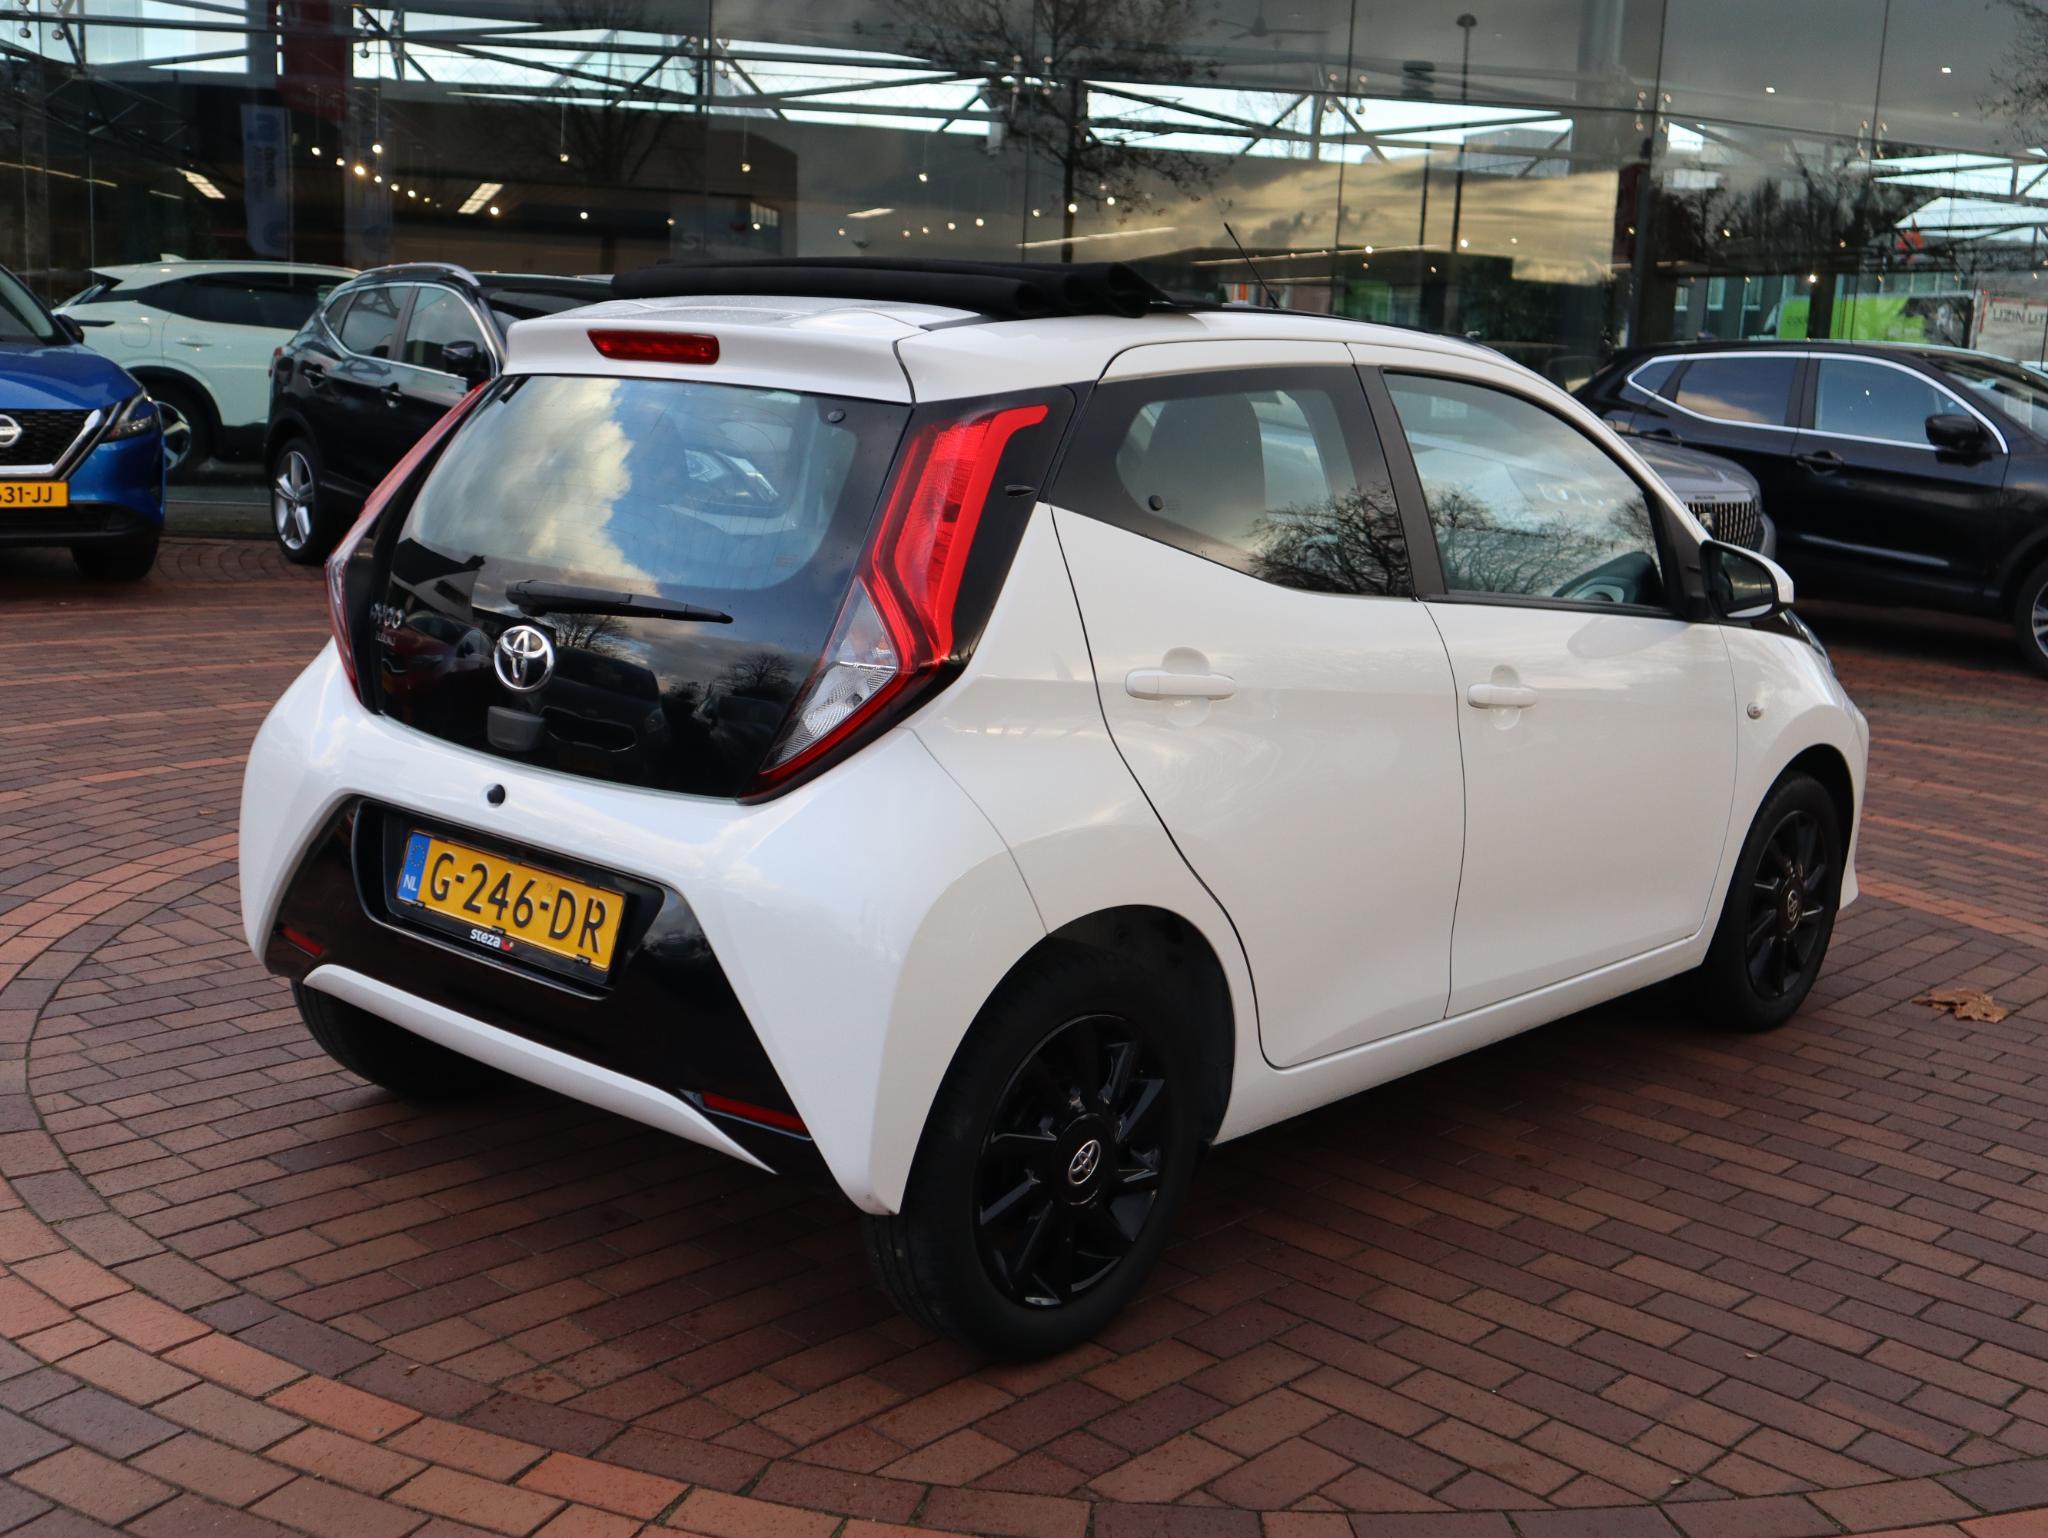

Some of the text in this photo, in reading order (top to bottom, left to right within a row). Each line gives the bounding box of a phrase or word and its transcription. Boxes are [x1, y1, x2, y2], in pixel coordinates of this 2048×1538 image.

[0, 486, 52, 503] 31-JJ
[403, 874, 417, 892] NL
[429, 852, 606, 953] G-246-DR
[470, 928, 501, 947] steza
